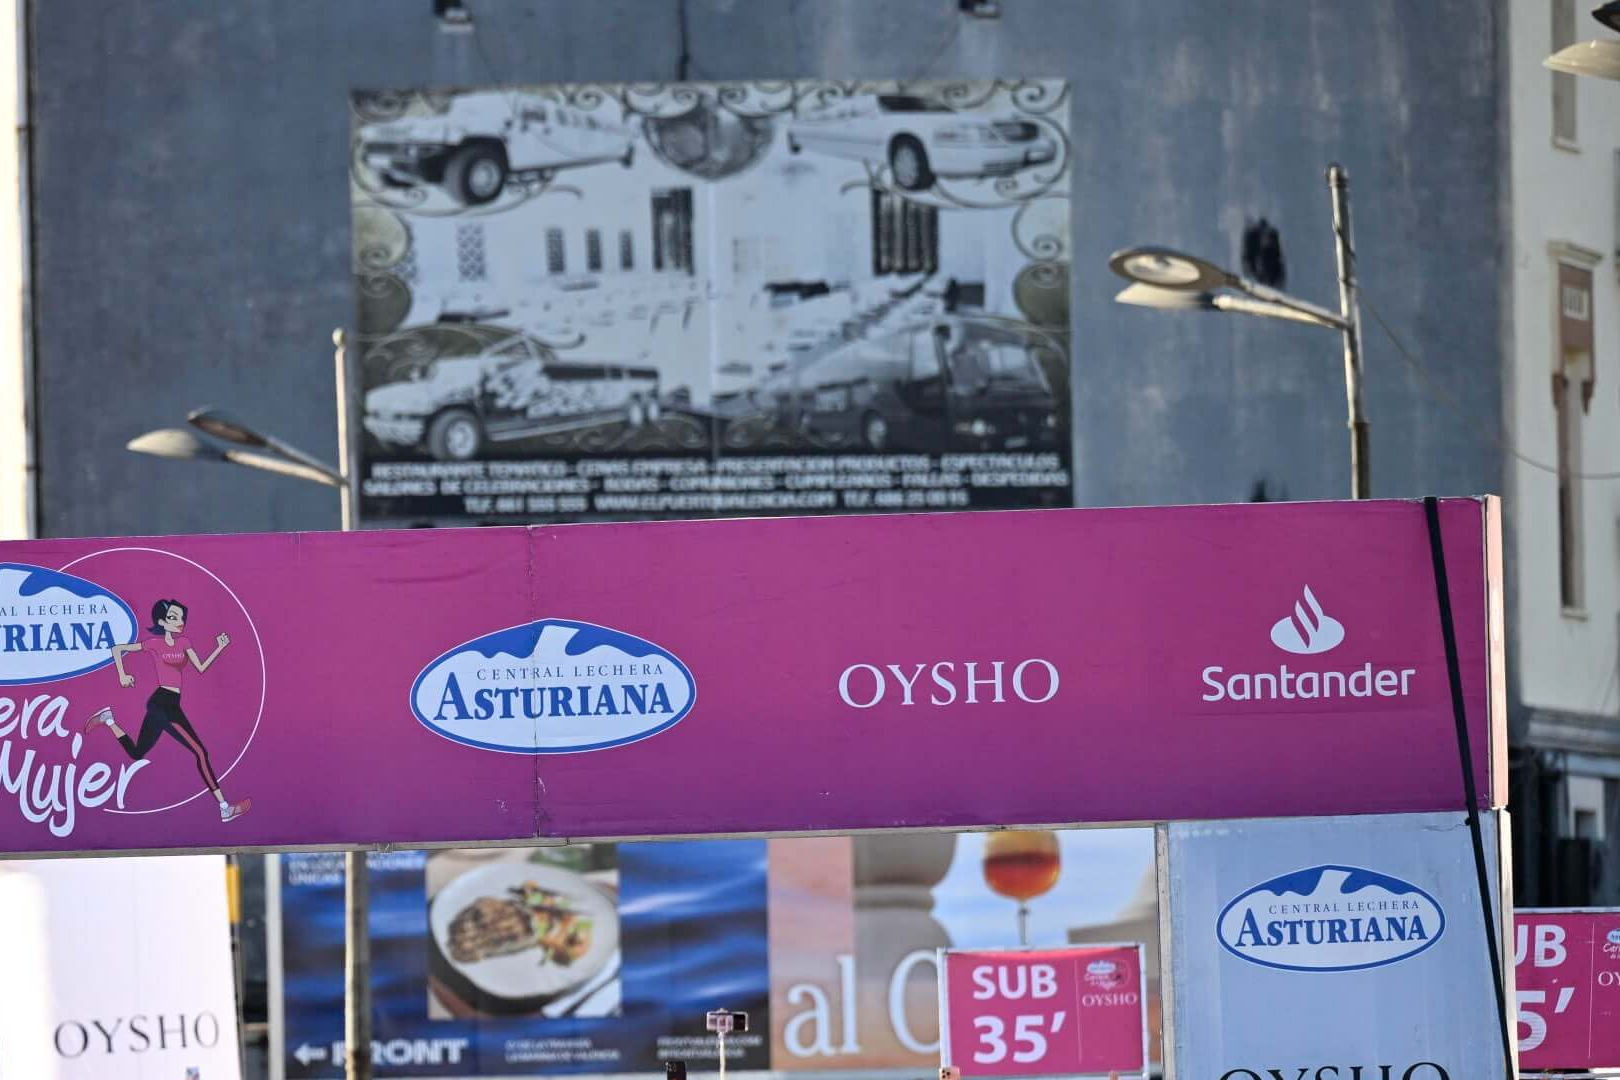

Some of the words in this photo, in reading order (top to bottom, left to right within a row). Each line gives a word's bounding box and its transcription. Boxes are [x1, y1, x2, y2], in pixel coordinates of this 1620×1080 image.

[27, 603, 109, 616] LECHERA
[477, 667, 564, 681] CENTRAL
[574, 663, 664, 677] LECHERA
[838, 658, 1060, 708] OYSHO
[1202, 662, 1416, 702] Santander
[433, 671, 674, 721] ASTURIANA
[1235, 907, 1428, 948] ASTURIANA
[1268, 903, 1340, 915] CENTRAL
[1347, 900, 1421, 912] LECHERA
[972, 964, 1058, 1001] SUB
[1082, 991, 1138, 1007] OYSHO
[784, 954, 860, 1058] al
[54, 1010, 219, 1059] OYSHO
[972, 1010, 1067, 1064] 35'
